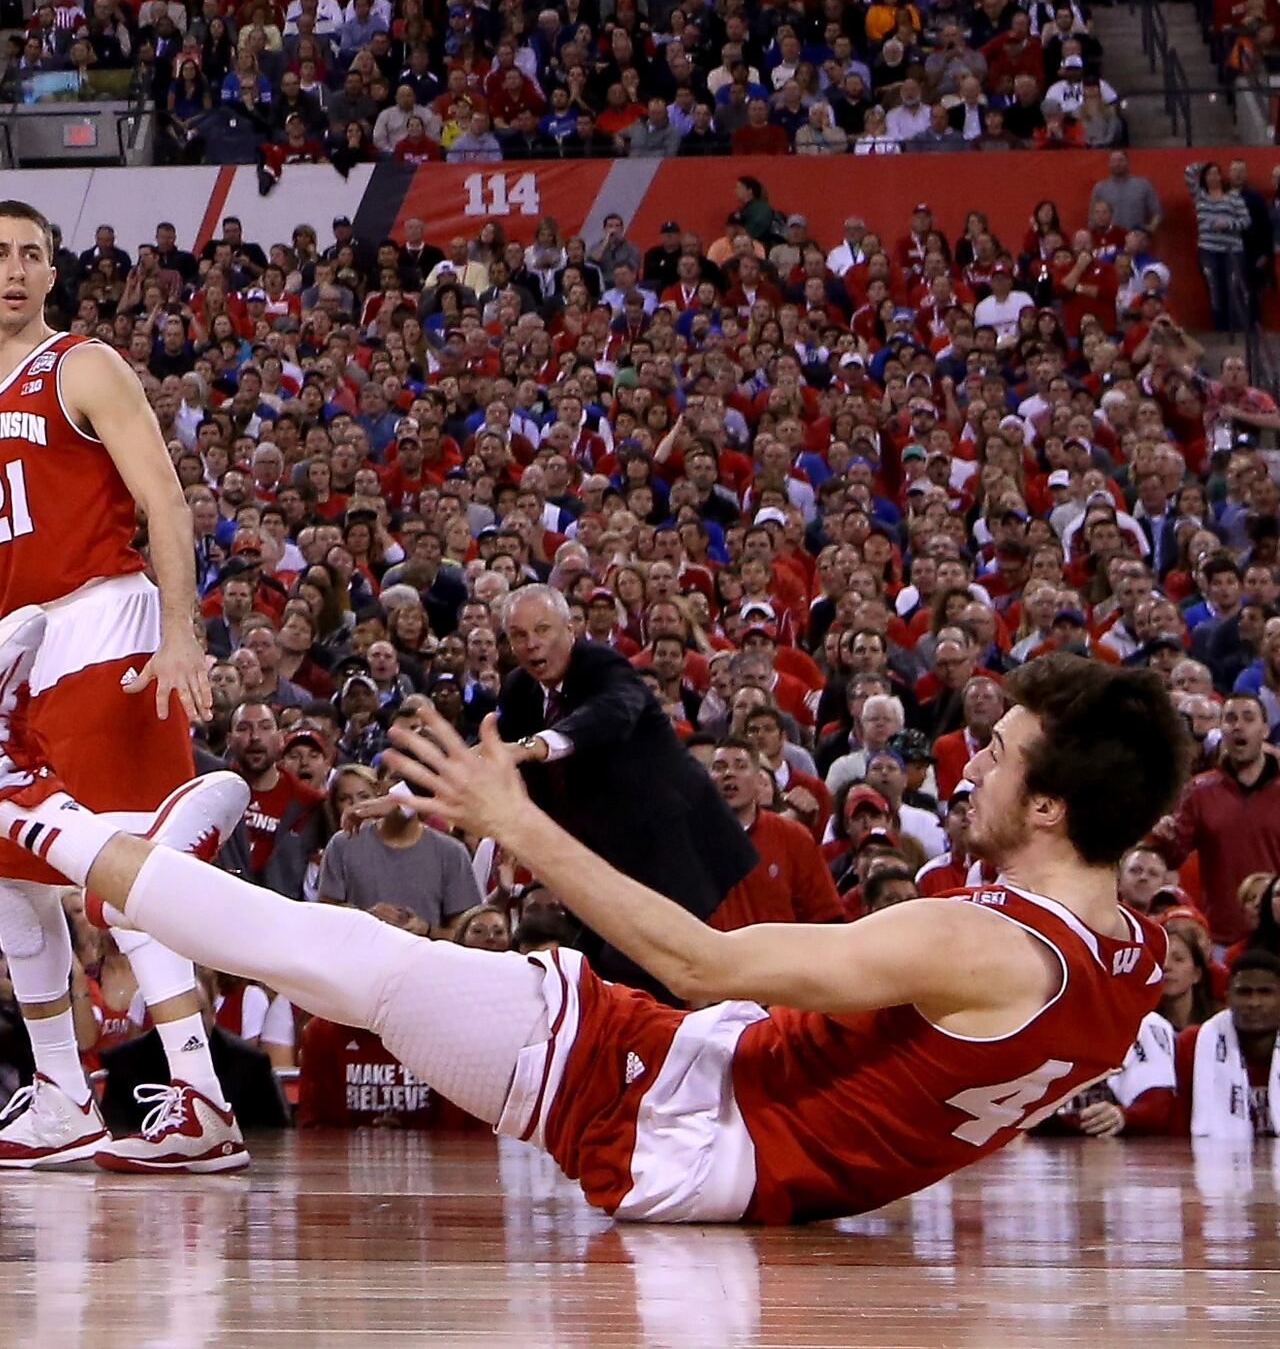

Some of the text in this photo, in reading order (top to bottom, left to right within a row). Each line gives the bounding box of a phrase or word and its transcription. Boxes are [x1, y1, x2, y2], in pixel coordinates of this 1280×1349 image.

[464, 173, 540, 216] 114
[346, 1064, 396, 1085] MAKE
[346, 1085, 431, 1111] BELIEVE
